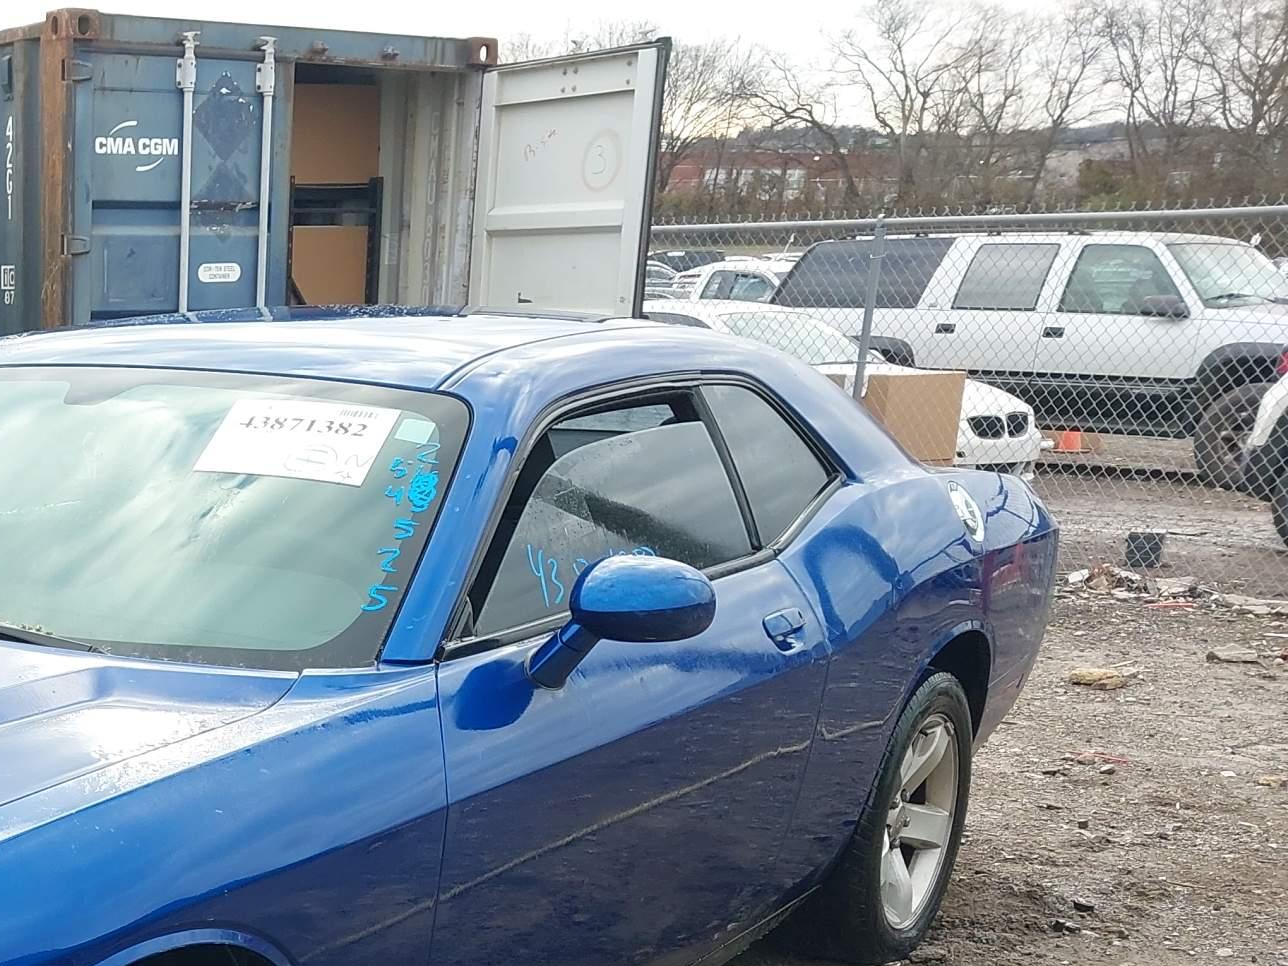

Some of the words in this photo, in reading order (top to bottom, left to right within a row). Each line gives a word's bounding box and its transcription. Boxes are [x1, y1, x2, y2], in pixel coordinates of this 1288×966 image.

[94, 136, 136, 155] CMA
[138, 137, 179, 156] CGM
[5, 115, 13, 220] 42G1
[239, 415, 369, 438] 43871382
